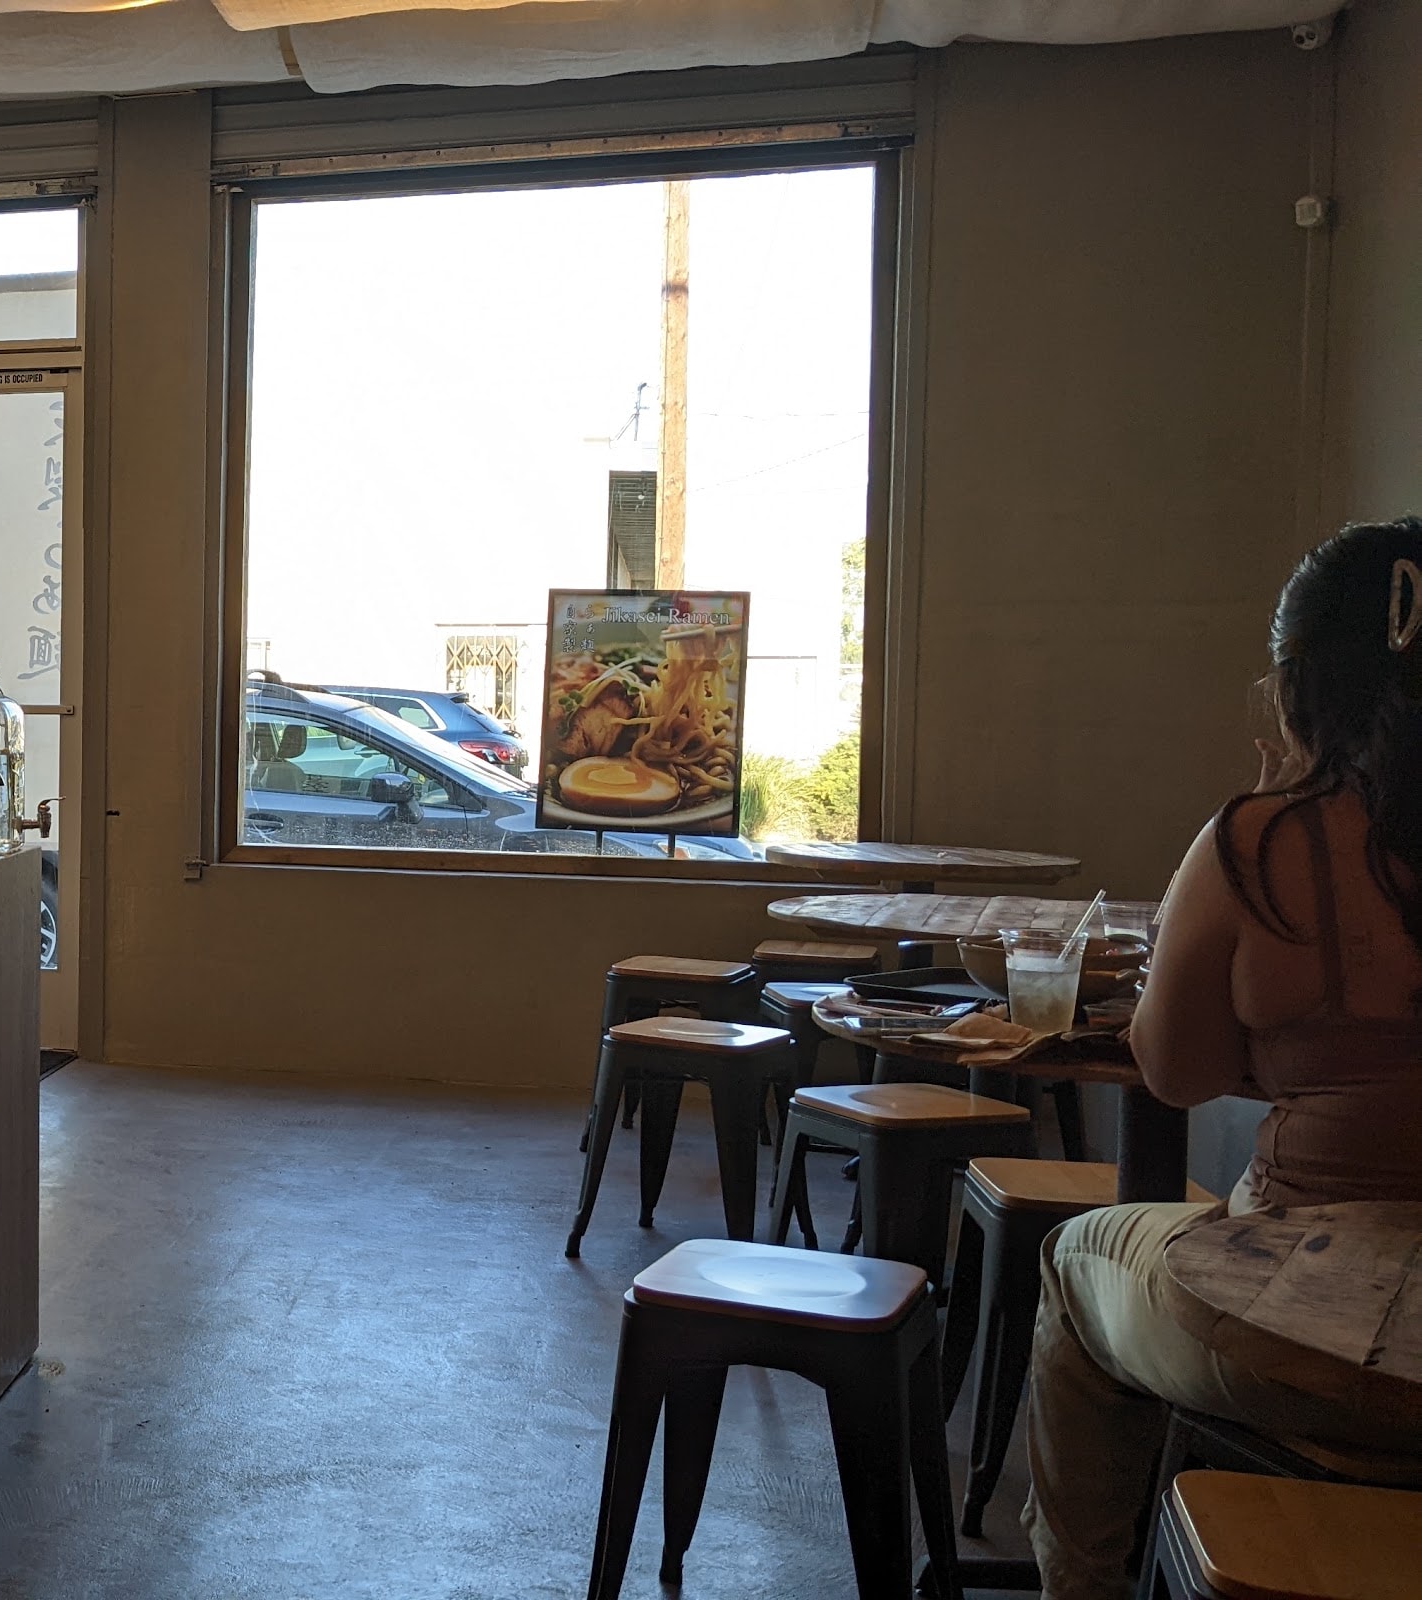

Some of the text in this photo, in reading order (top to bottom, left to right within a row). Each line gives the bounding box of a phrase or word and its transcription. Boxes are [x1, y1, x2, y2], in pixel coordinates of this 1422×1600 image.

[4, 375, 11, 384] IS
[12, 374, 43, 384] OCCUPIED
[601, 606, 730, 624] Jikasei Ramen
